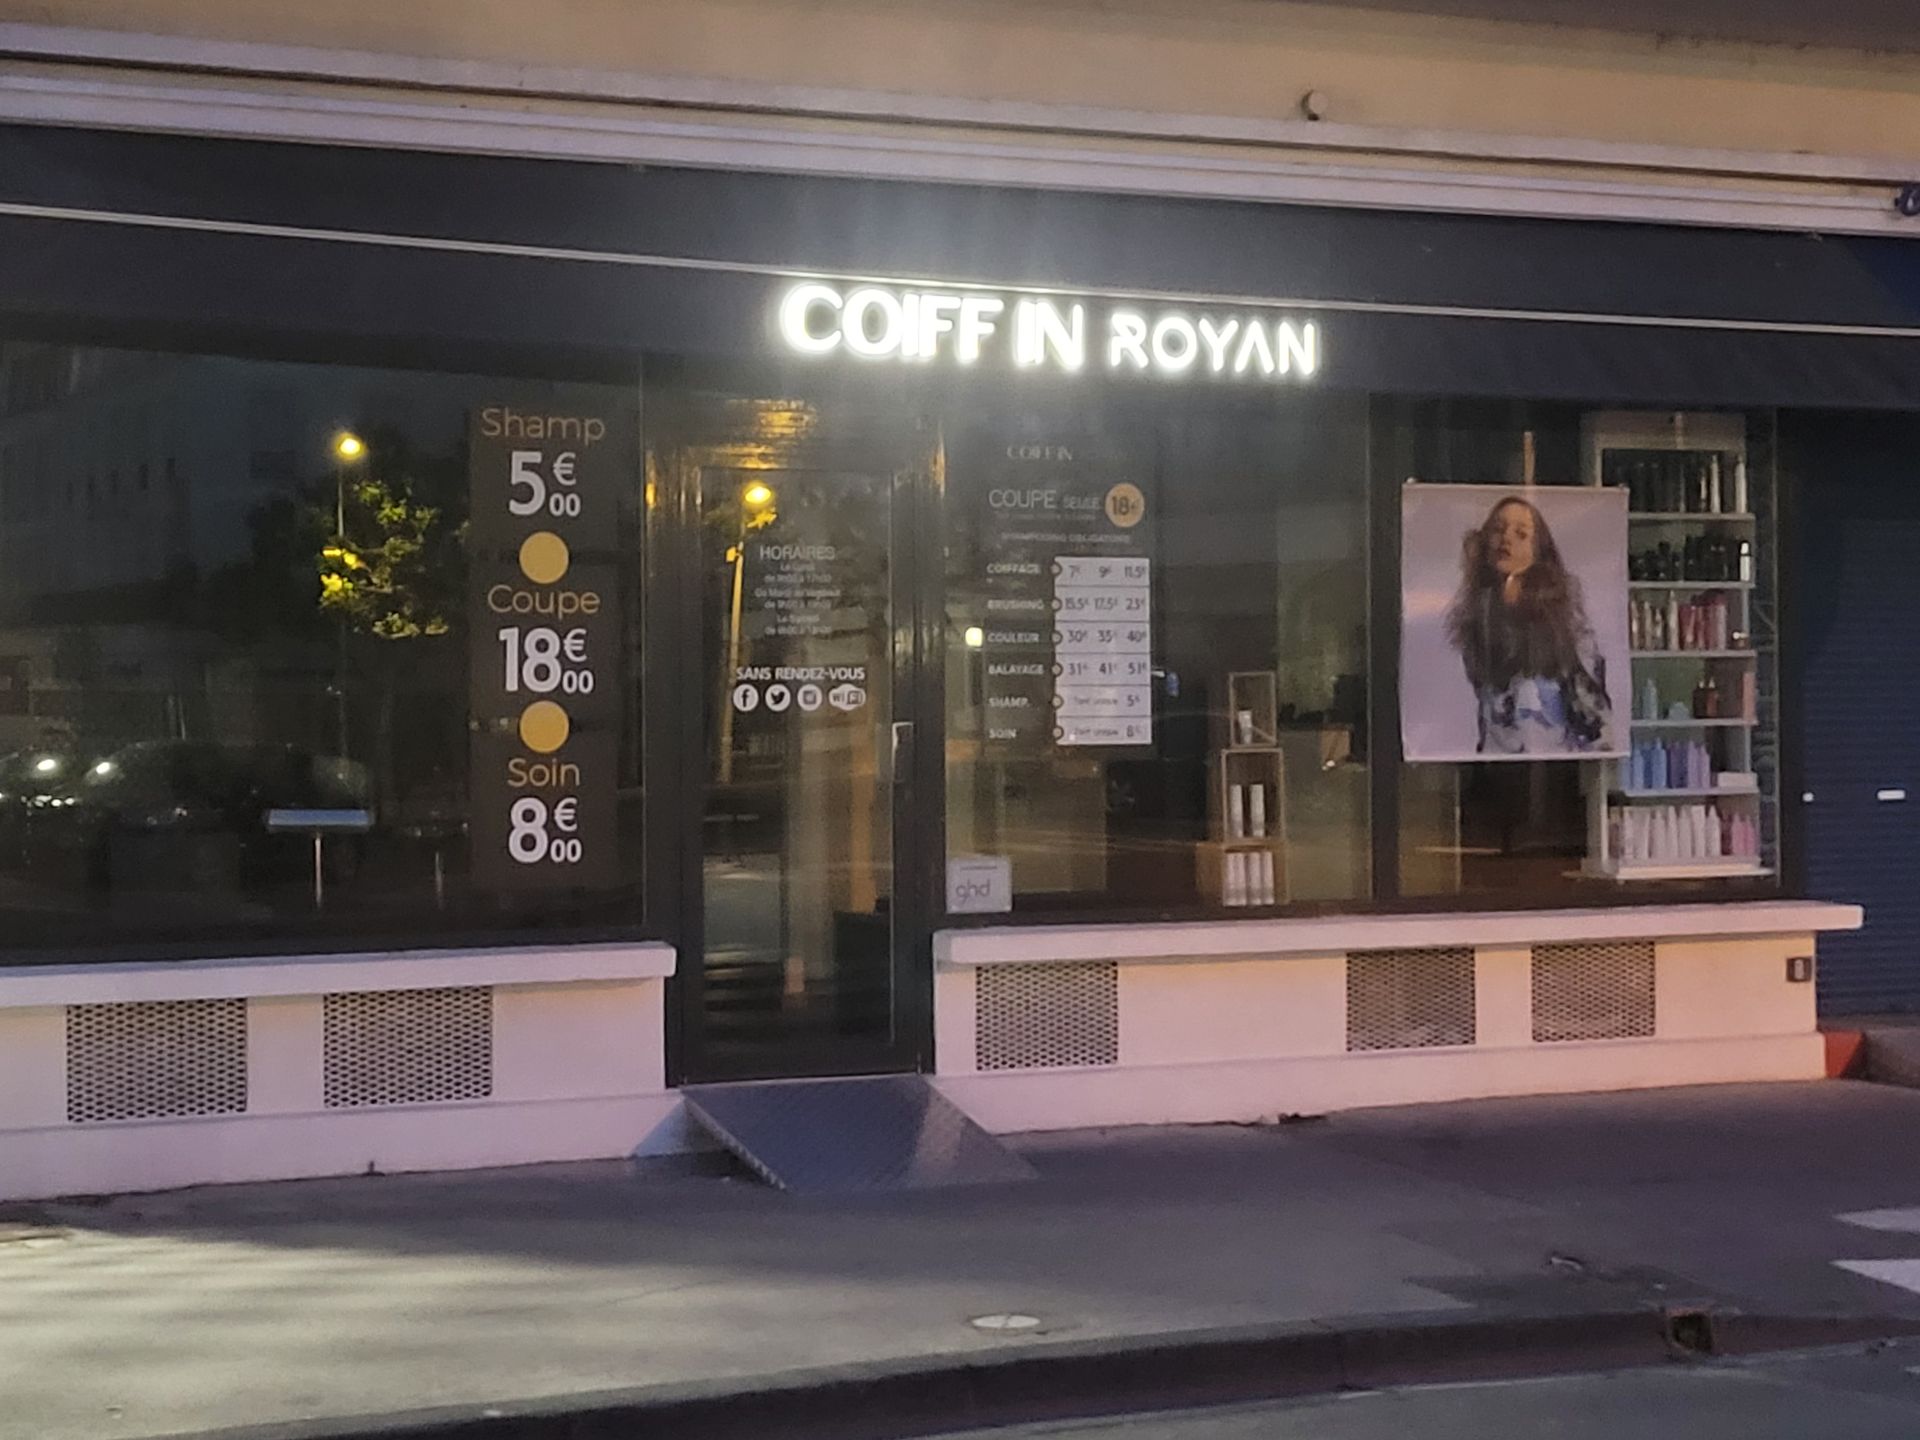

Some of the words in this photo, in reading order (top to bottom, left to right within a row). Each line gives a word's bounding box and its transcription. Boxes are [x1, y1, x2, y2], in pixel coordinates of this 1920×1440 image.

[782, 284, 1004, 362] COIFF
[1014, 300, 1085, 370] IN
[1108, 312, 1318, 376] ROYAN
[480, 407, 606, 446] Shamp
[988, 489, 1057, 508] COUPE
[759, 546, 836, 560] HORAIRES
[487, 584, 601, 620] Coupe
[987, 632, 1040, 643] COULEUR
[736, 667, 771, 680] SANS
[775, 667, 865, 680] RENDEZ-VOUS
[988, 664, 1044, 675] BALAYAGE
[988, 728, 1017, 740] SOIN
[507, 758, 580, 787] Soin
[955, 879, 991, 905] ghd
